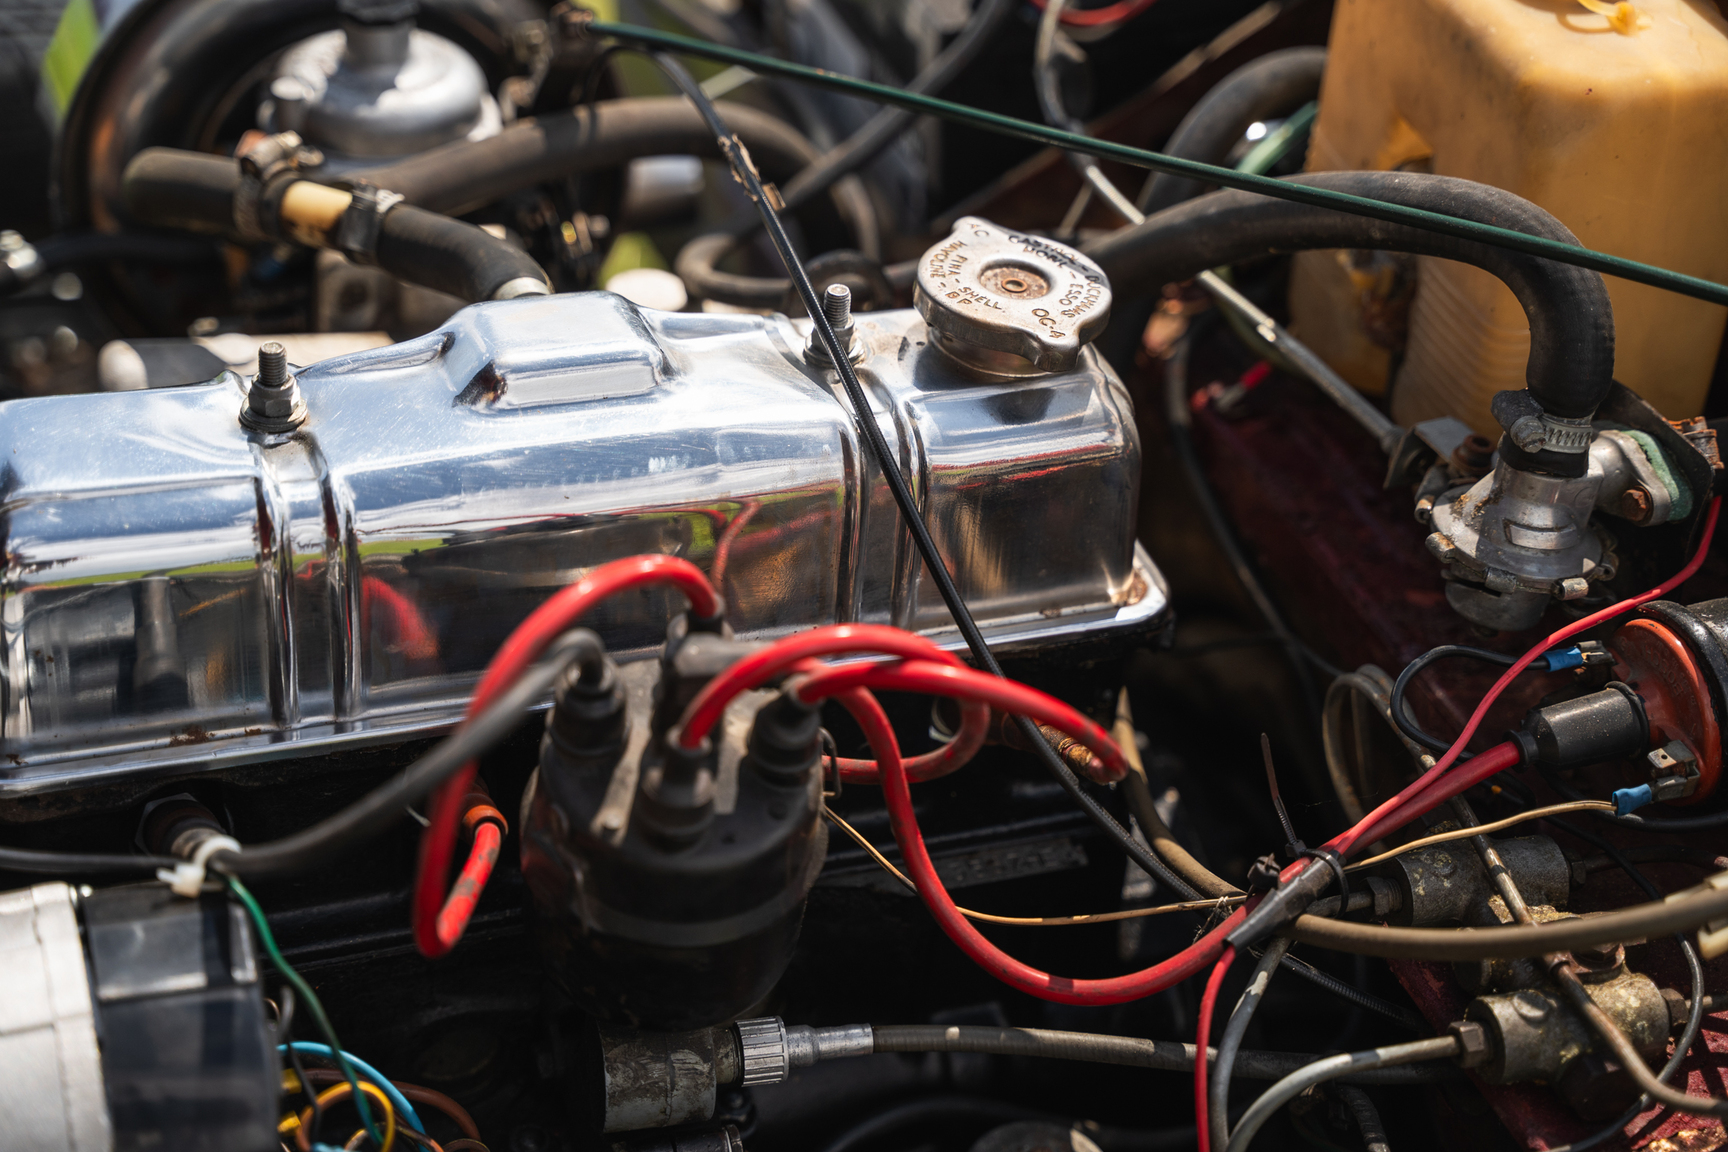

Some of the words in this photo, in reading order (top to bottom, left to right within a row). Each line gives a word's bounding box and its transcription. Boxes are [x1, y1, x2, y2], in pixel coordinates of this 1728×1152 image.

[929, 240, 969, 278] HAVOLINE
[945, 291, 973, 305] BP
[948, 254, 968, 276] FINA
[958, 286, 1002, 310] SHELL
[1059, 283, 1084, 306] ESSO
[1061, 275, 1101, 318] DUCKHAMS
